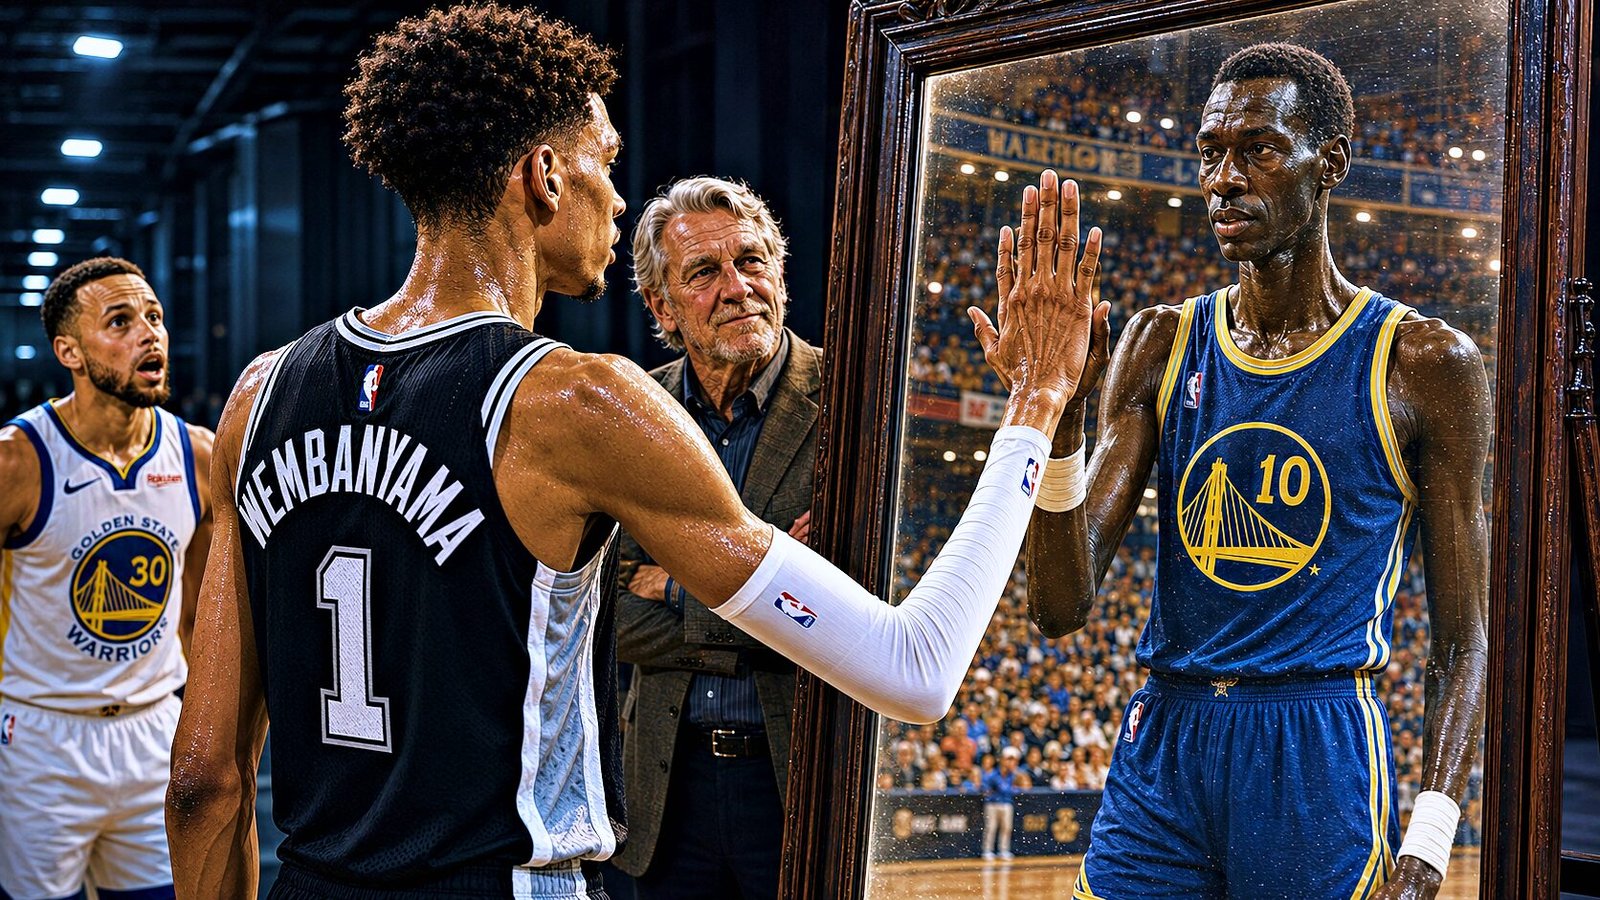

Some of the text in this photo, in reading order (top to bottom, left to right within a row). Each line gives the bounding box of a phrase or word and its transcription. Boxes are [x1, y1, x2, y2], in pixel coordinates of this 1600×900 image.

[239, 425, 485, 566] WEMBANYAMA
[1256, 454, 1311, 506] 10
[71, 516, 180, 560] GOLDEN STATE
[129, 555, 166, 587] 30
[316, 545, 392, 753] 1
